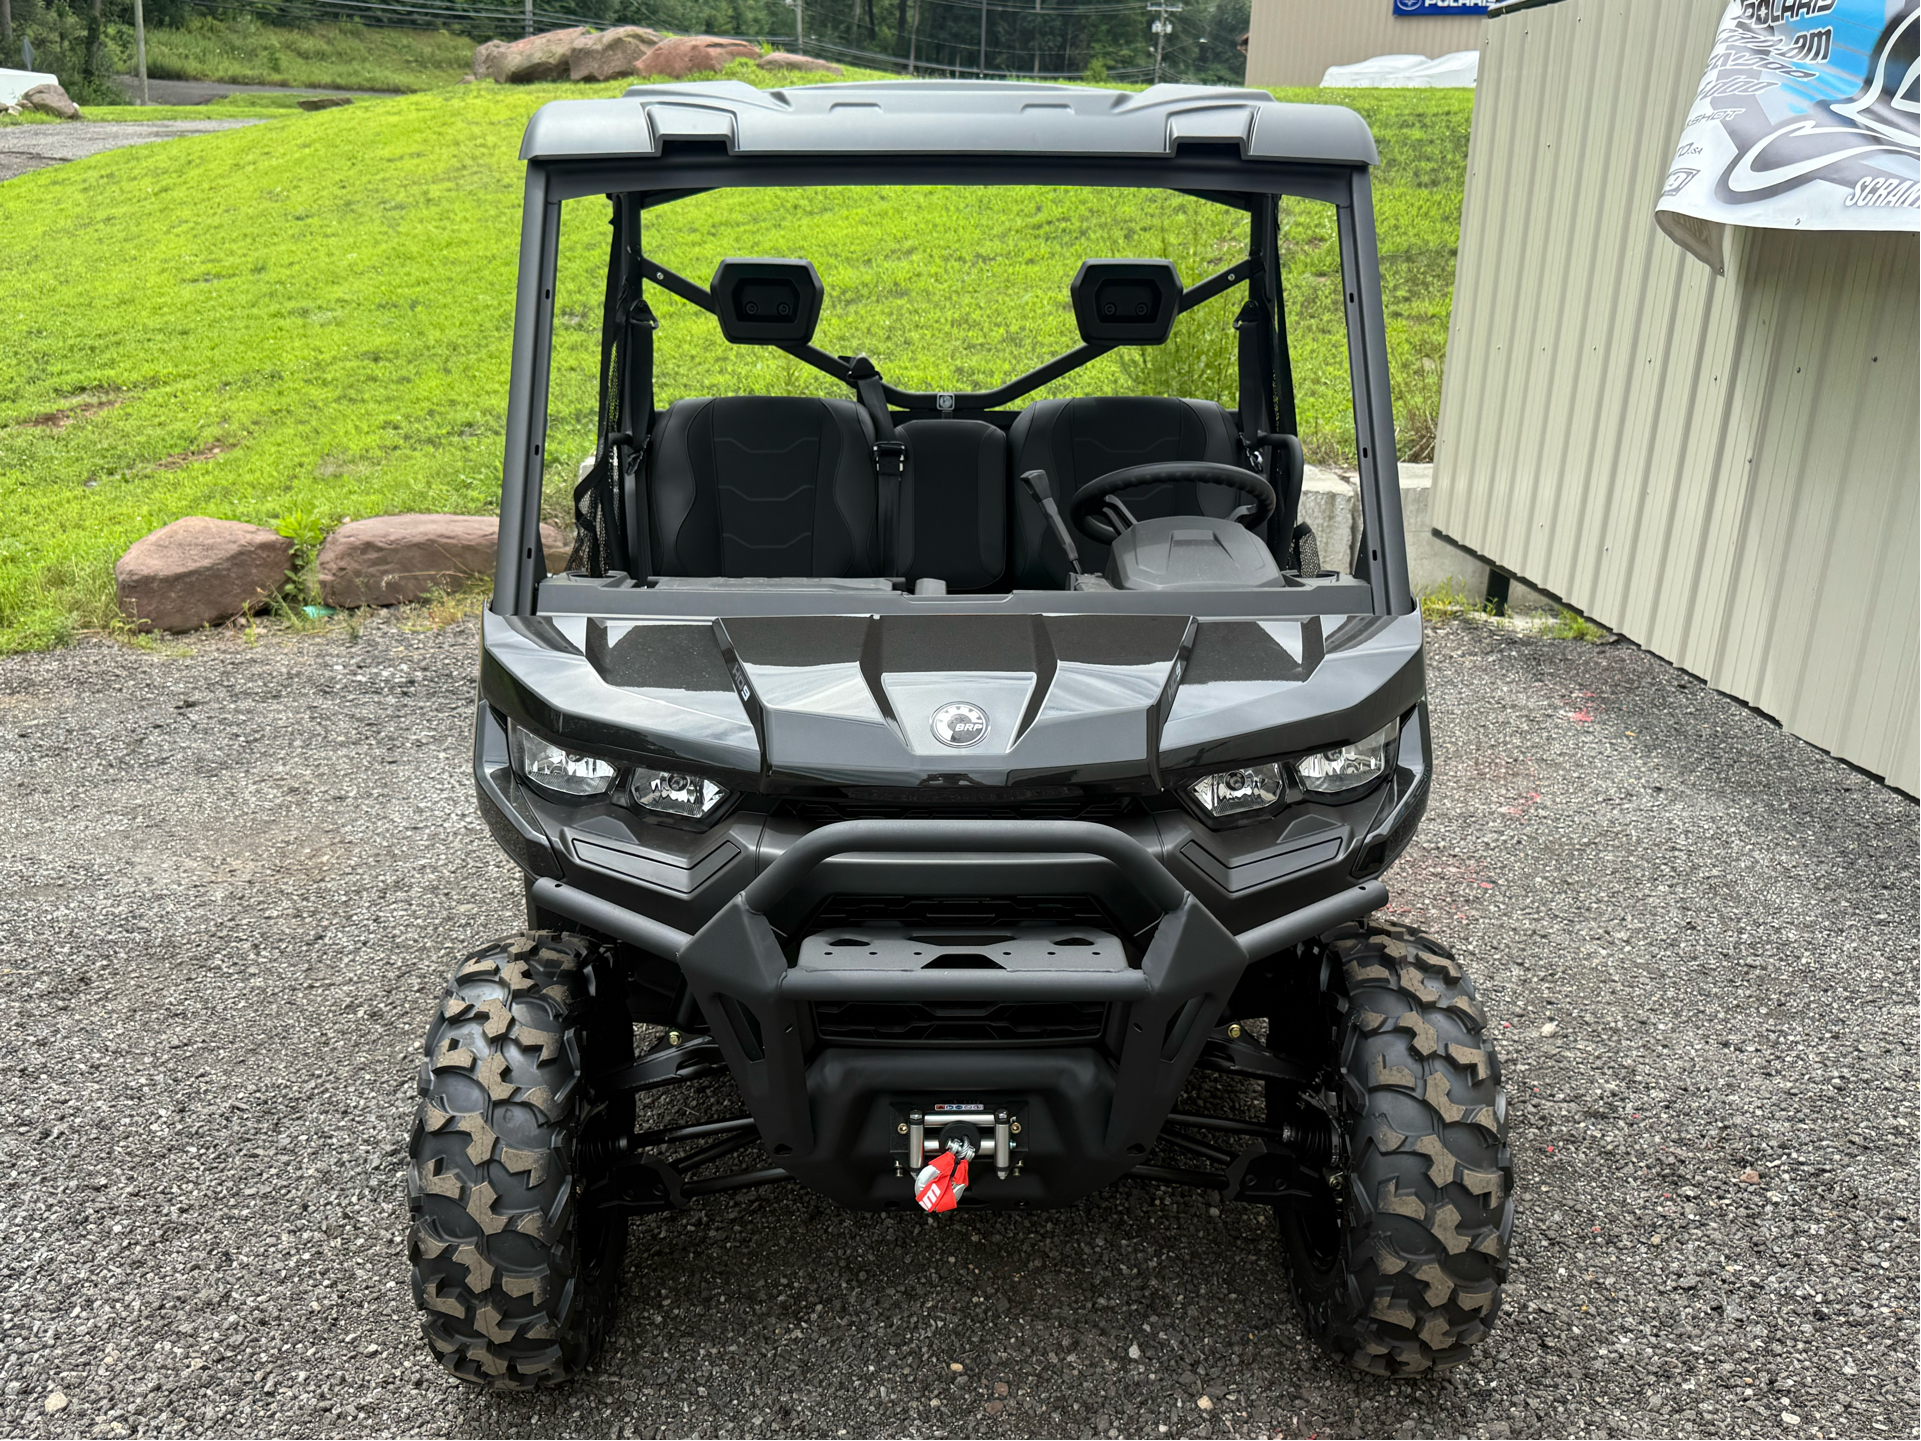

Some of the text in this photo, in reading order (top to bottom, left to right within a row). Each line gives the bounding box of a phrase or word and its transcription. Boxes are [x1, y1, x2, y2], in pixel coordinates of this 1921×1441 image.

[1732, 0, 1836, 25] POLARIS
[731, 662, 750, 702] HD9
[955, 723, 983, 732] BRP
